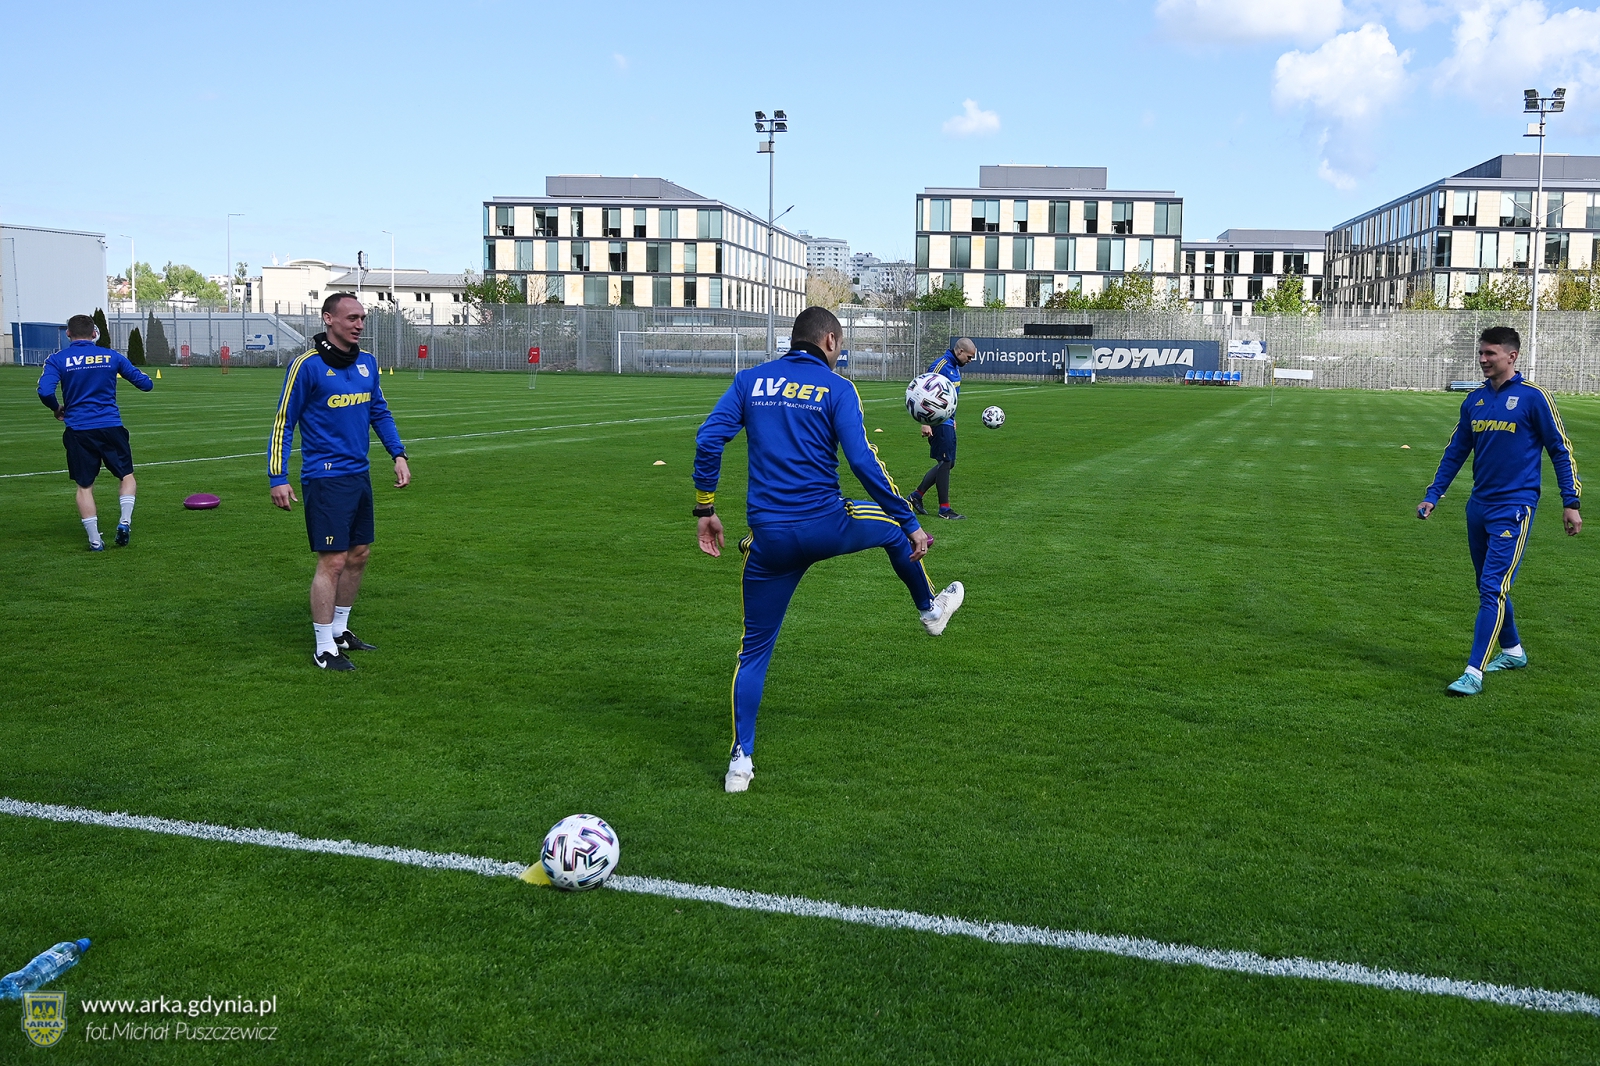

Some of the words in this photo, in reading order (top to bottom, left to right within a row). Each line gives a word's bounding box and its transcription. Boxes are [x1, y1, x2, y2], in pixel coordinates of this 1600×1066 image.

[1095, 347, 1194, 370] GDYNIA
[327, 392, 371, 408] GDYNI
[1471, 420, 1516, 433] GDYNIA
[324, 462, 332, 470] 17
[325, 536, 334, 545] 17
